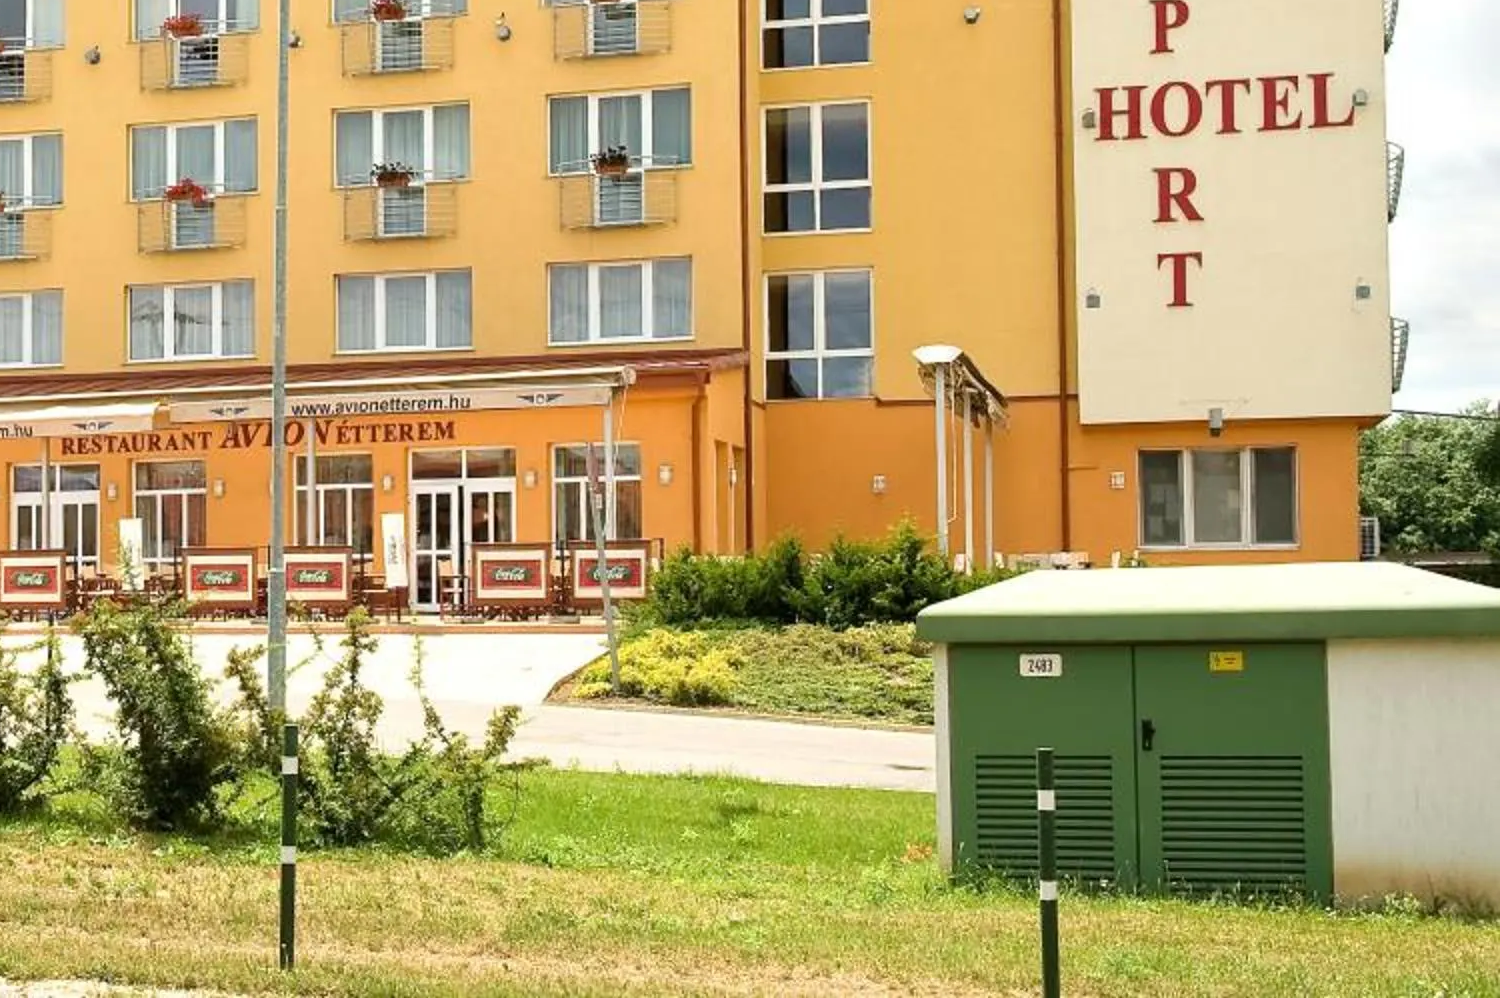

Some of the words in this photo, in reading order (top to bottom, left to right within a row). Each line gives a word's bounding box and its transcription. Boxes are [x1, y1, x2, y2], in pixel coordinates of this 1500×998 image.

[1093, 72, 1356, 142] HOTEL
[290, 395, 472, 417] www.avionetterem.hu
[61, 431, 213, 456] RESTAURANT
[219, 418, 334, 449] AVION
[336, 419, 456, 445] ÉTTEREM
[1027, 658, 1053, 673] 2483
